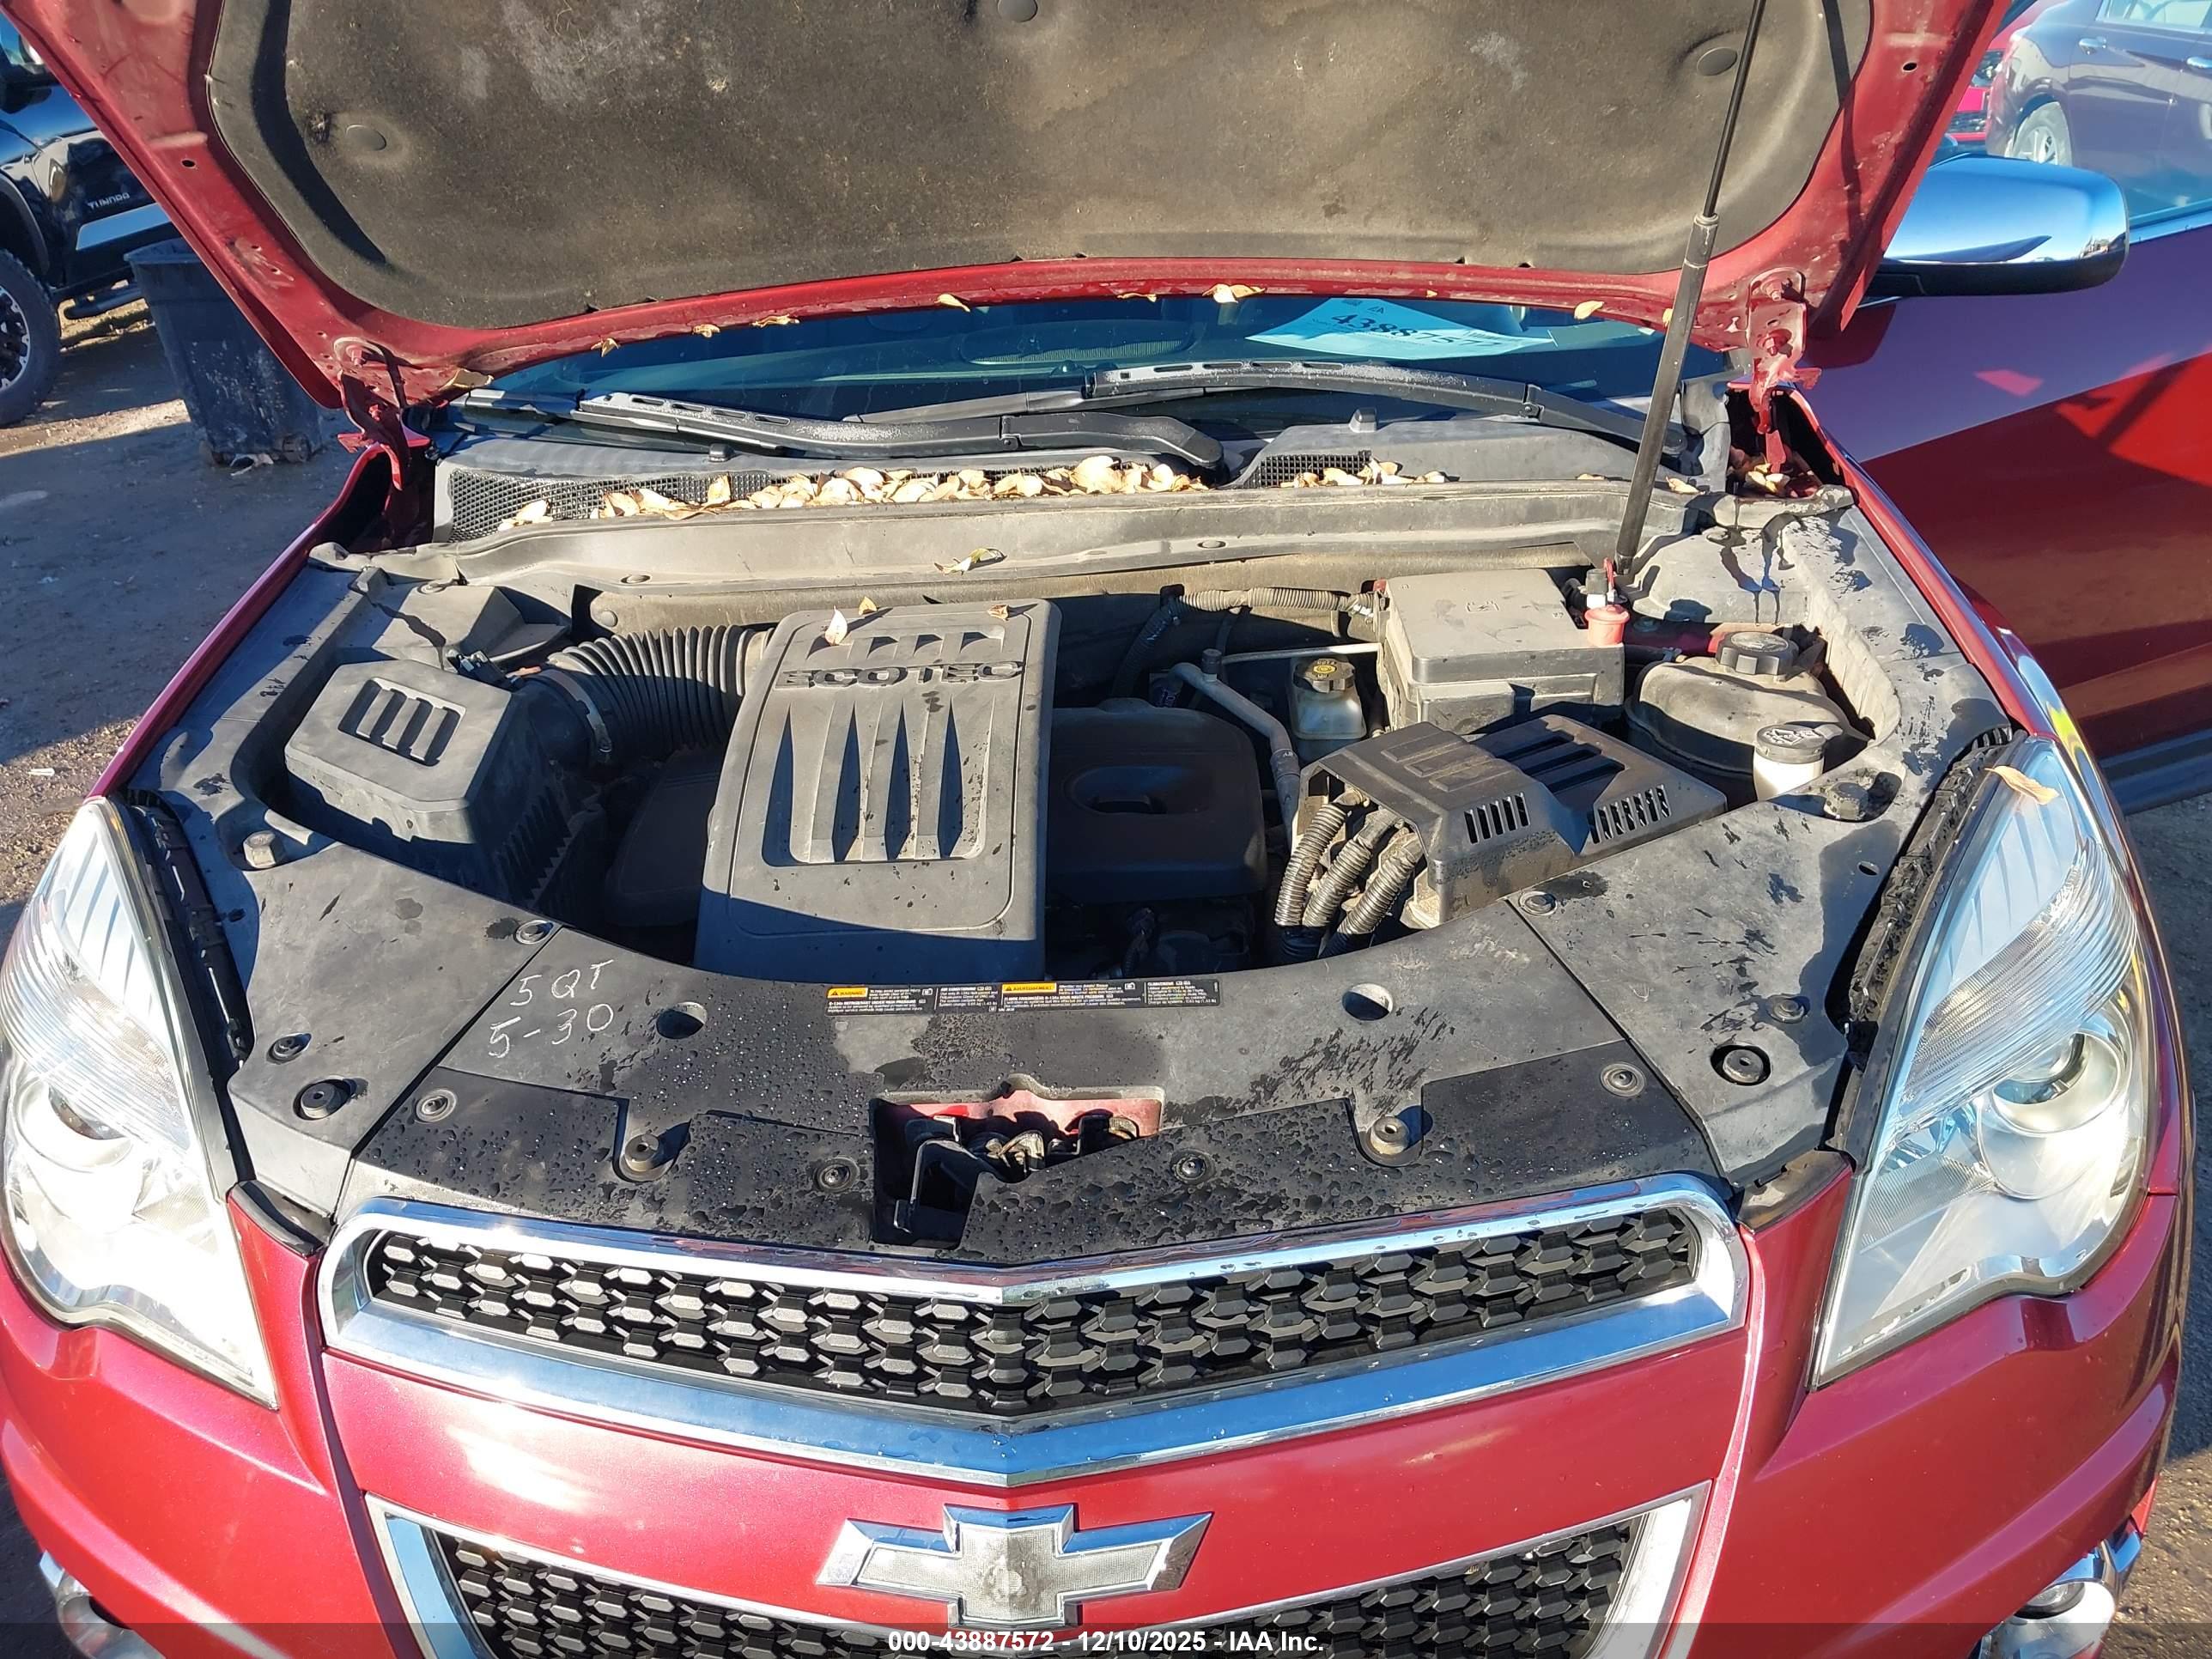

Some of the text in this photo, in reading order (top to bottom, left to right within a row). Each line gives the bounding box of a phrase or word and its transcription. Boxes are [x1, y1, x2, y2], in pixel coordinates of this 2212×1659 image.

[775, 661, 1023, 690] ECOTEC
[510, 959, 615, 1006] 5 QT
